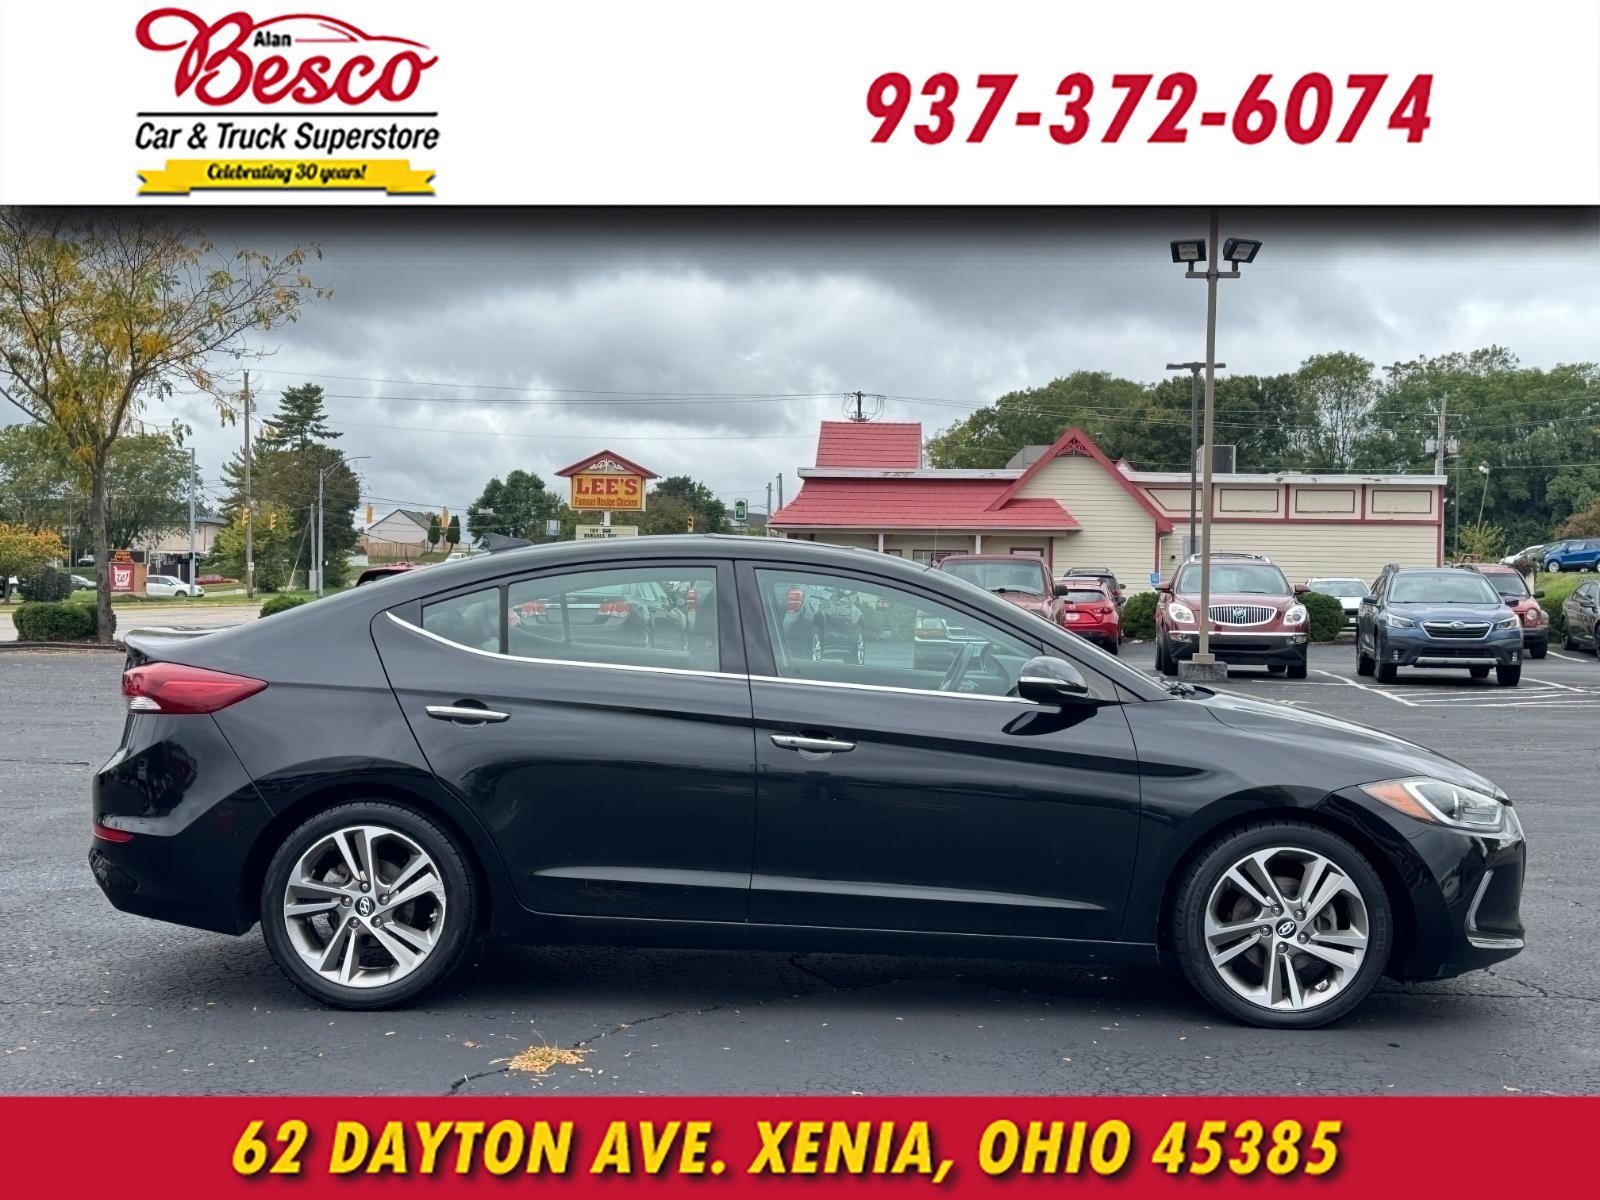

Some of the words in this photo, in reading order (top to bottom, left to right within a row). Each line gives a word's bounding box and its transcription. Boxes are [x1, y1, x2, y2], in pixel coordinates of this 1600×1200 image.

[576, 478, 638, 495] LEE'S
[597, 497, 615, 508] Recipe
[616, 498, 638, 507] Chicken
